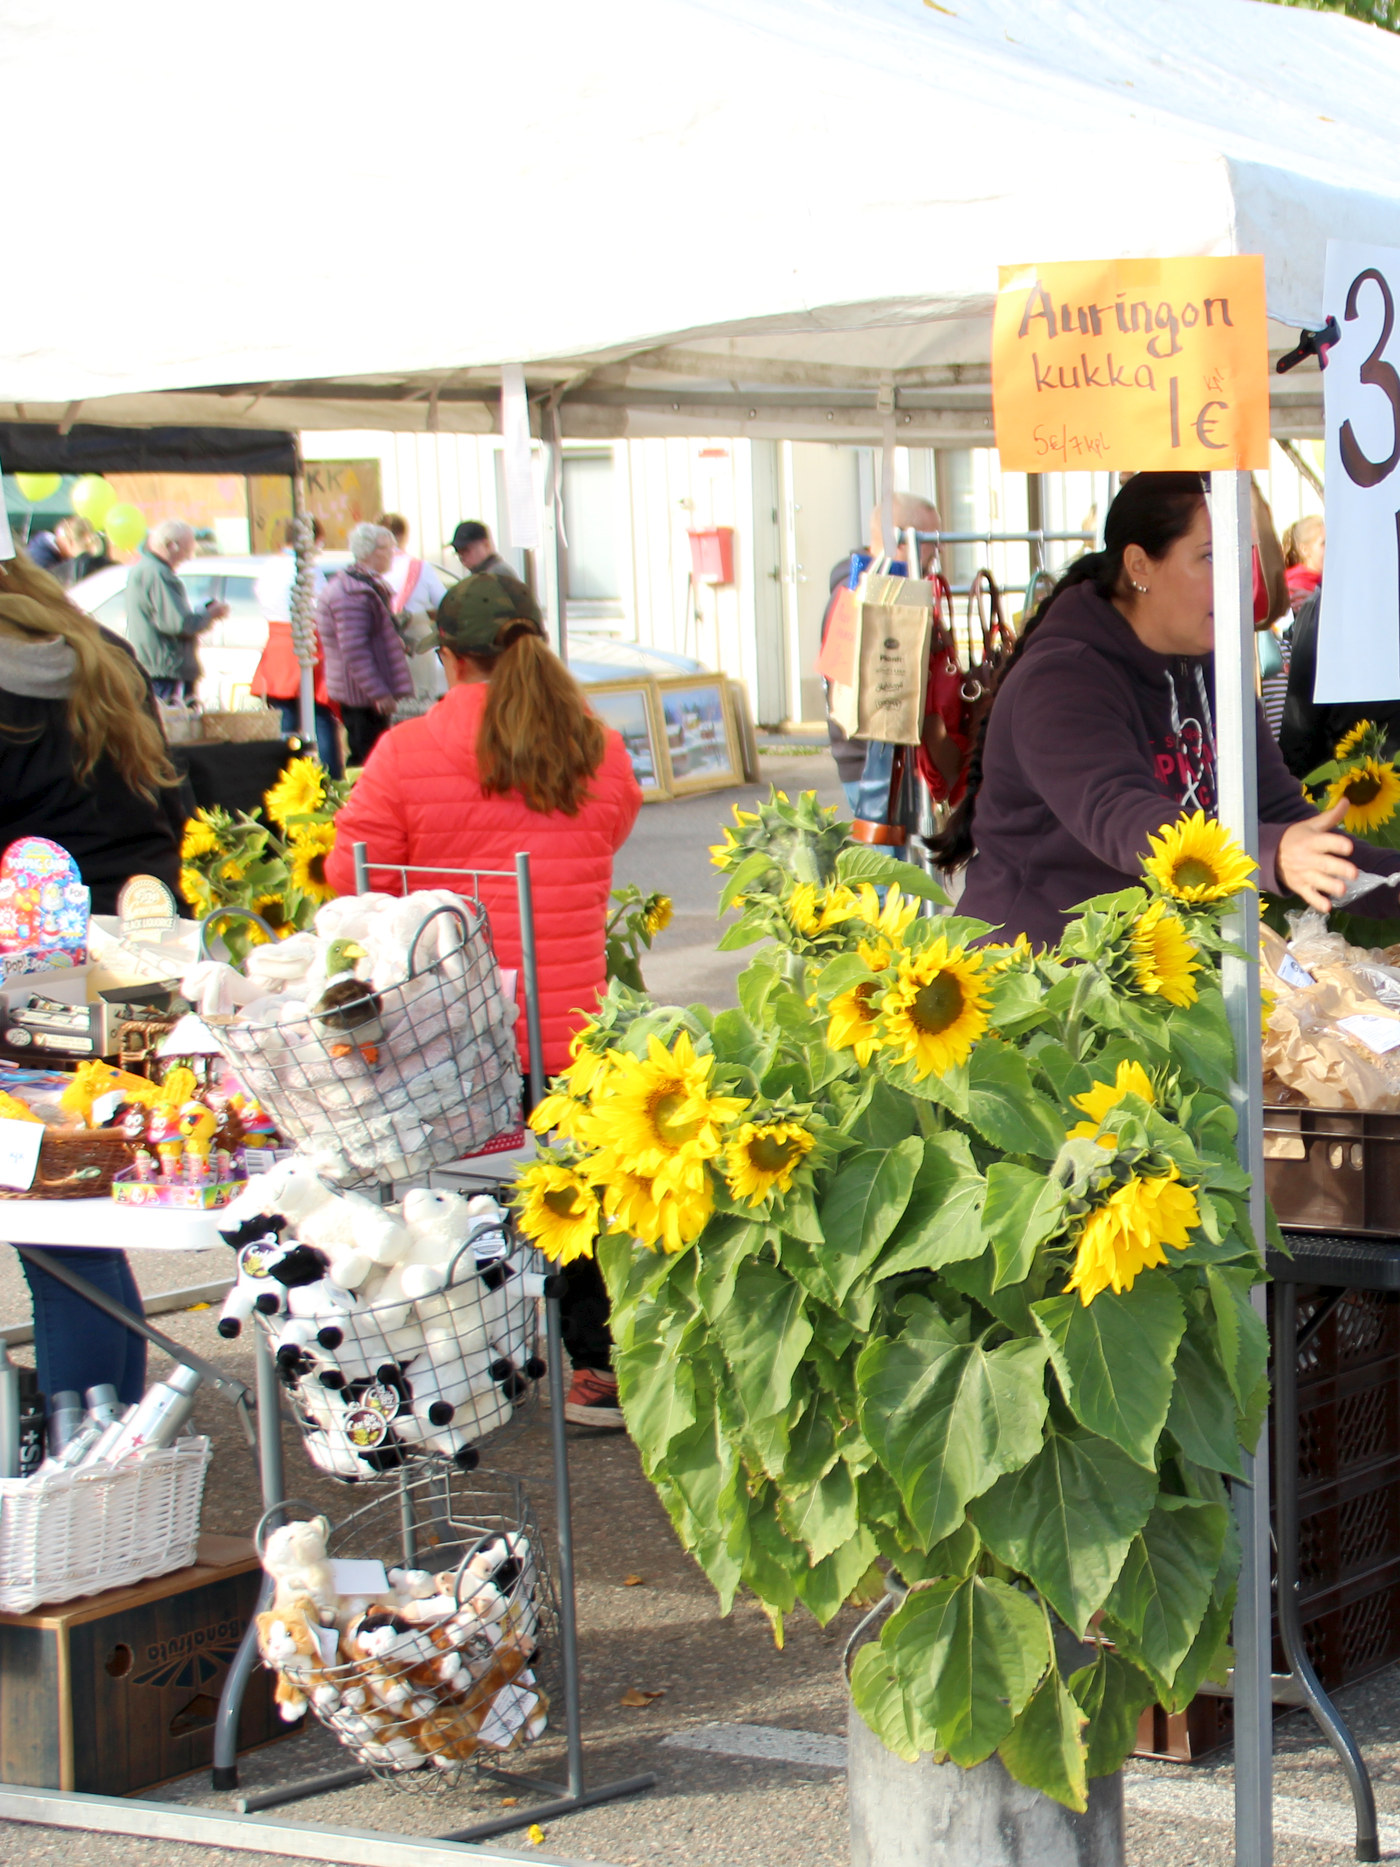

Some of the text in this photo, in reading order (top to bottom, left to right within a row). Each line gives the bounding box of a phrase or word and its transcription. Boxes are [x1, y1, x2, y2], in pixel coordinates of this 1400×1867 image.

[1018, 280, 1234, 359] Auringon
[1032, 353, 1156, 392] kukka
[147, 1618, 240, 1661] Bonafruta
